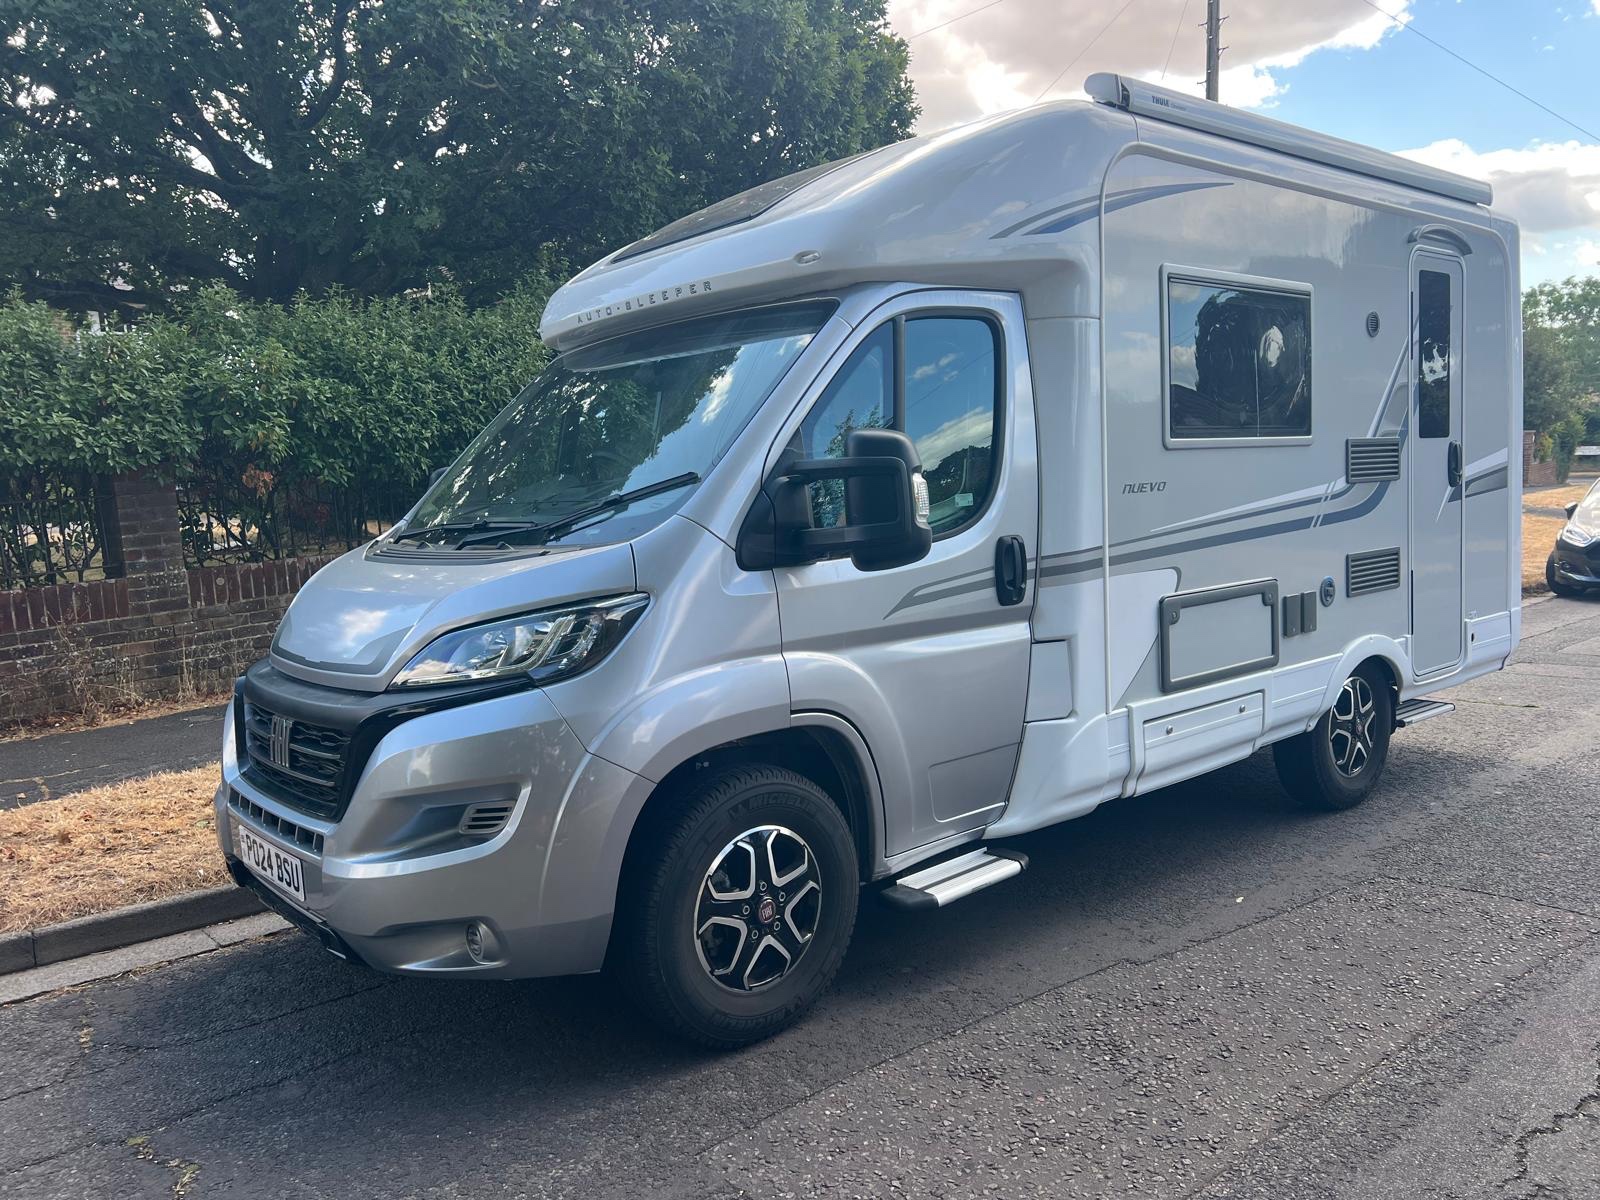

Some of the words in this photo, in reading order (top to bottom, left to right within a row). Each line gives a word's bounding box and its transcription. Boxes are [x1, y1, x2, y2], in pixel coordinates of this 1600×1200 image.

[1152, 95, 1170, 107] THULE
[268, 715, 293, 767] FIAT
[245, 833, 273, 877] PO24
[275, 851, 300, 893] BSU
[761, 904, 773, 919] FIAT
